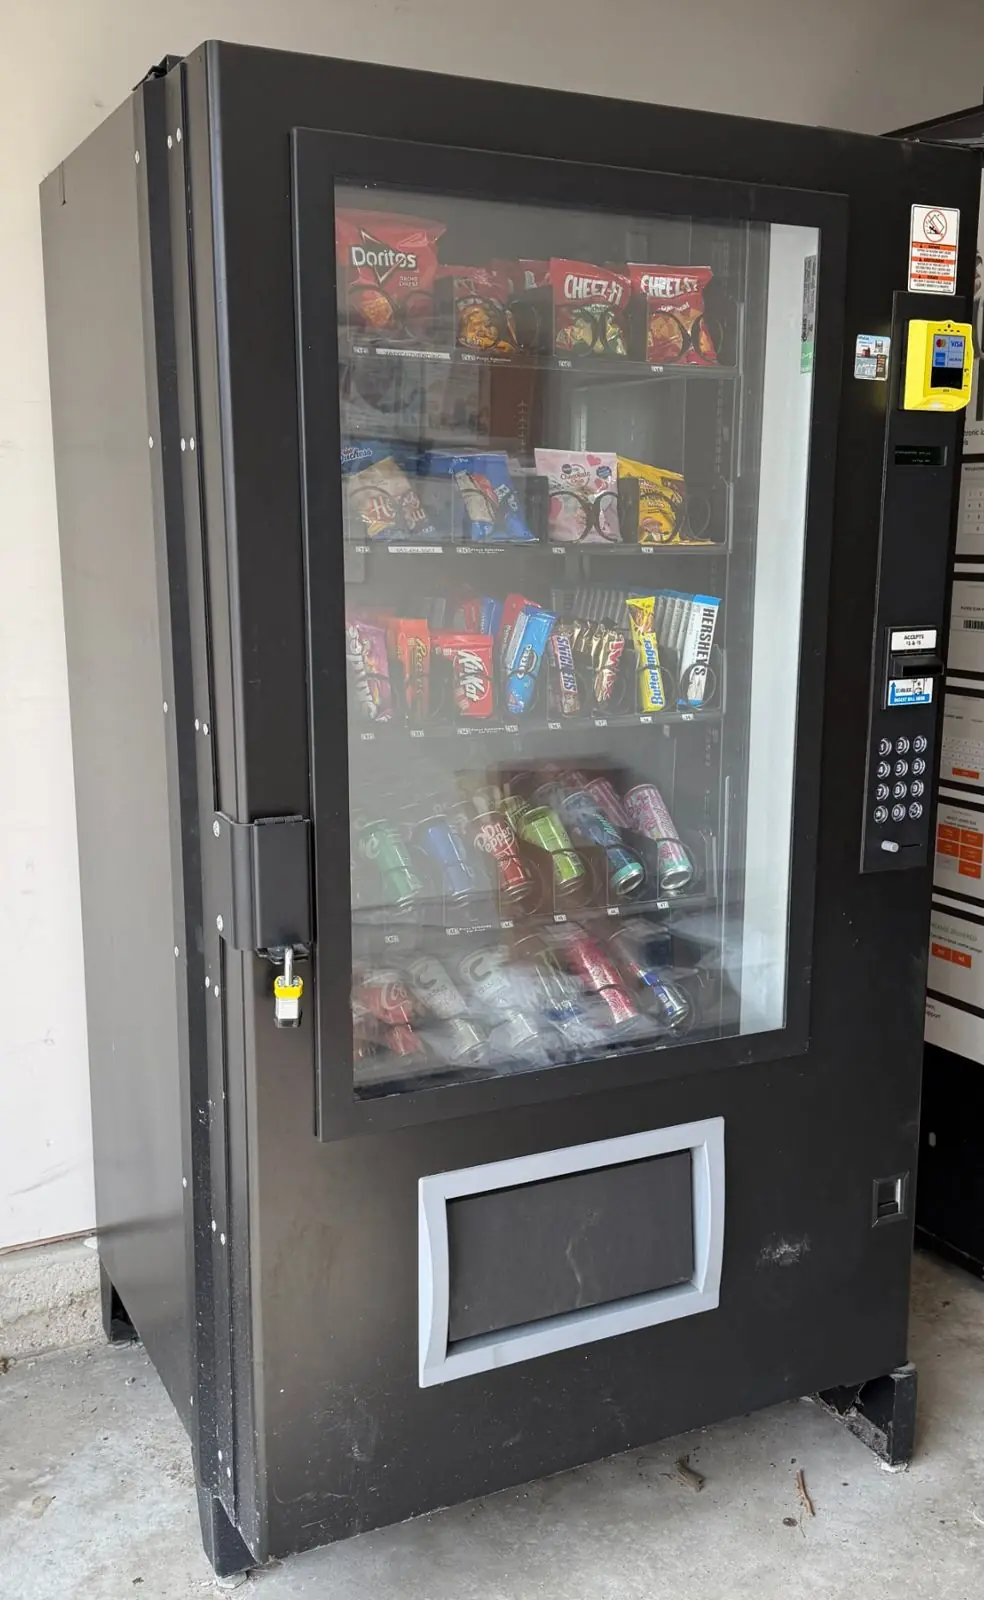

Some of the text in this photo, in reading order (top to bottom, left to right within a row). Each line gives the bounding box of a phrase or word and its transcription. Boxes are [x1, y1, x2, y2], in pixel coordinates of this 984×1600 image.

[351, 245, 417, 268] Doritos
[950, 340, 963, 348] VISA
[694, 608, 716, 676] HERSHEYS
[904, 633, 925, 641] ACCEPTS
[557, 636, 577, 692] SNICERS
[474, 827, 515, 853] Pepper
